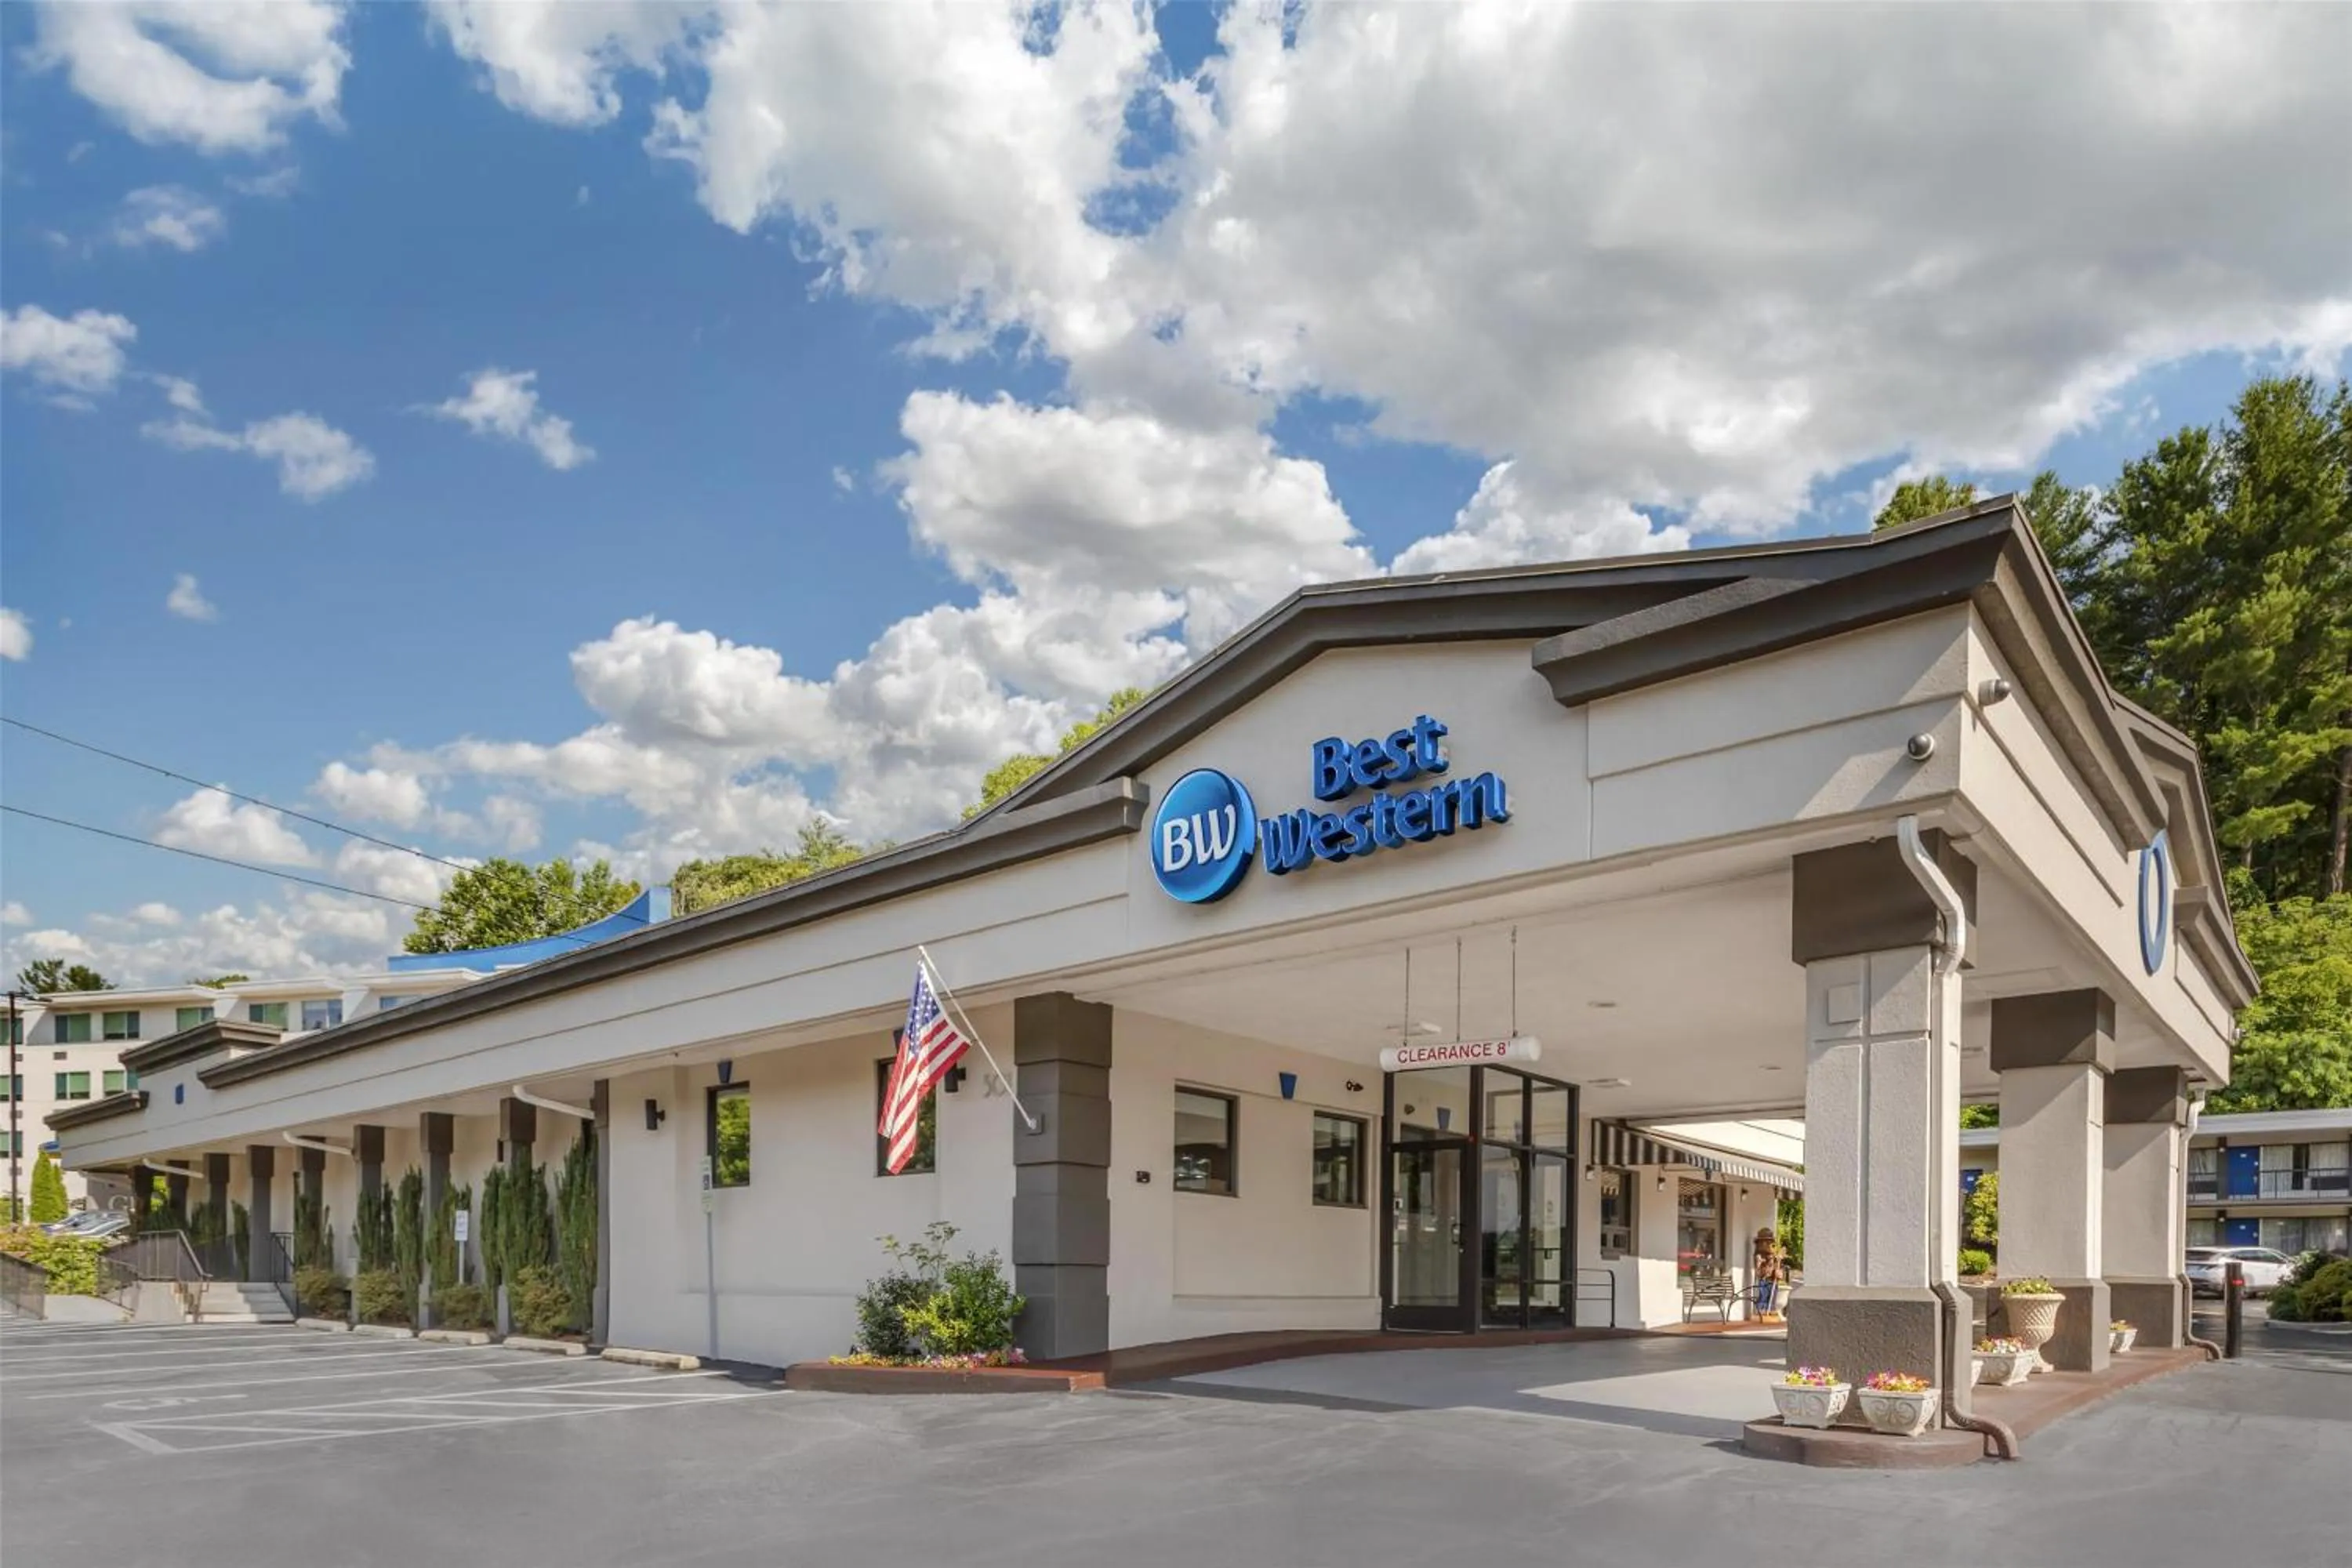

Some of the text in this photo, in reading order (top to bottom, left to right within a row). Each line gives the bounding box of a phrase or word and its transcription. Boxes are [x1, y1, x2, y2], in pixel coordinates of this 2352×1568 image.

[1312, 714, 1449, 801] Best
[1163, 804, 1236, 873] BW
[1259, 771, 1508, 876] Western
[1397, 1043, 1492, 1064] CLEARANCE
